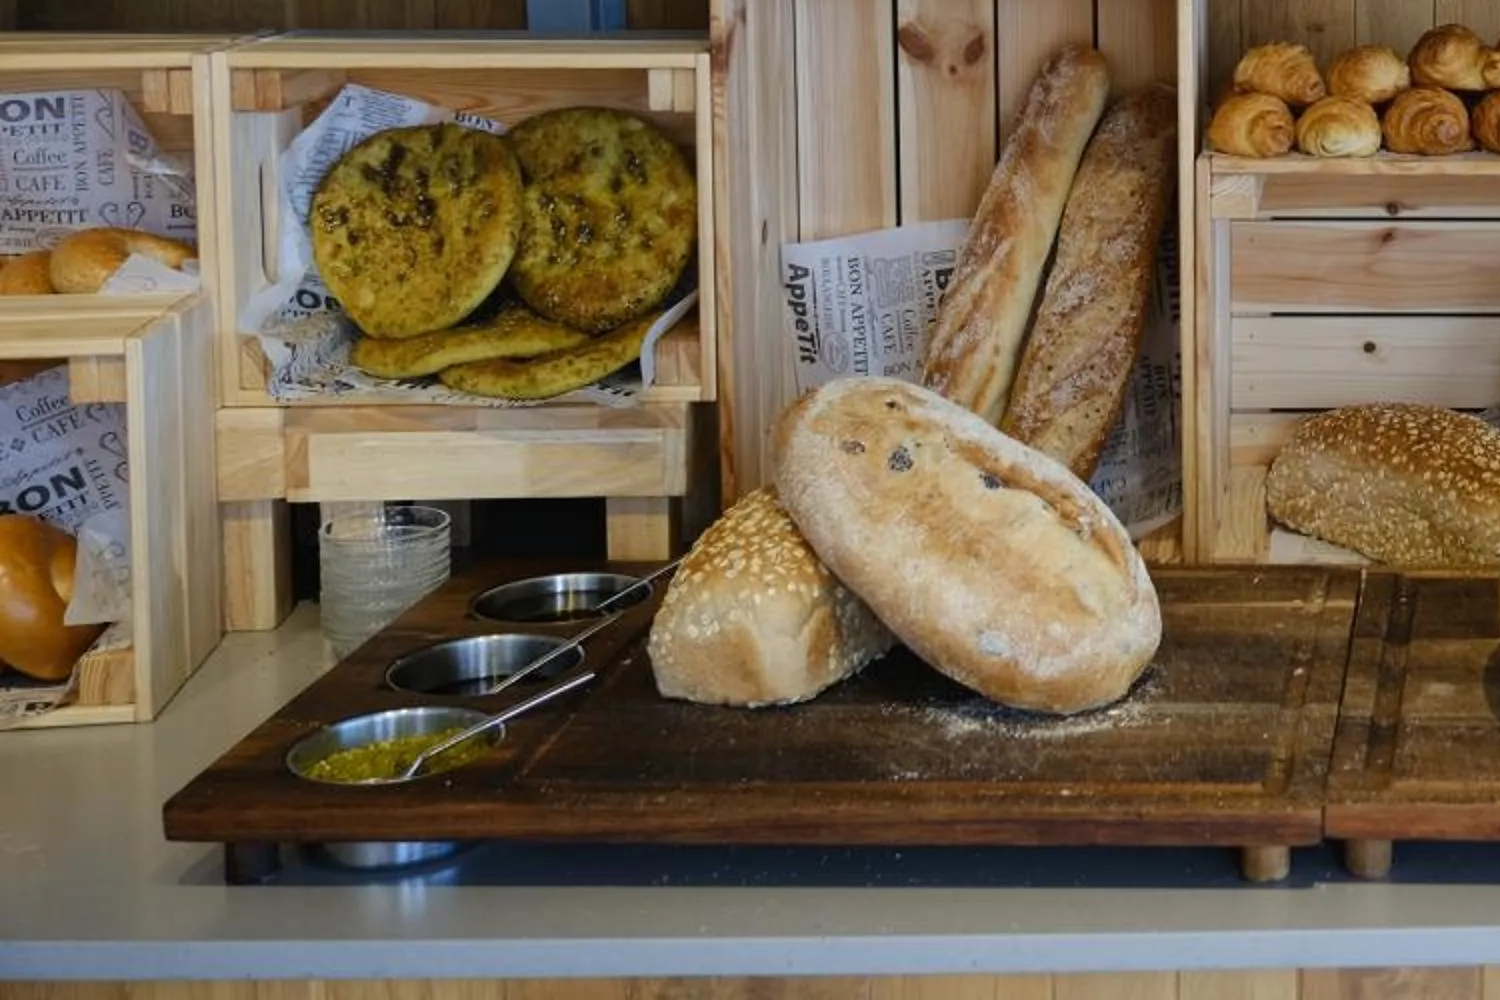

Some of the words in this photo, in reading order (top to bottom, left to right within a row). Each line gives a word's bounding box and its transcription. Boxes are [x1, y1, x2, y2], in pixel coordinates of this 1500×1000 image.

[13, 147, 68, 165] Coffee
[15, 174, 66, 191] CAFE
[847, 257, 863, 296] BON
[785, 263, 818, 365] AppeTit
[851, 302, 869, 377] APPETIT
[32, 411, 86, 443] CAFE
